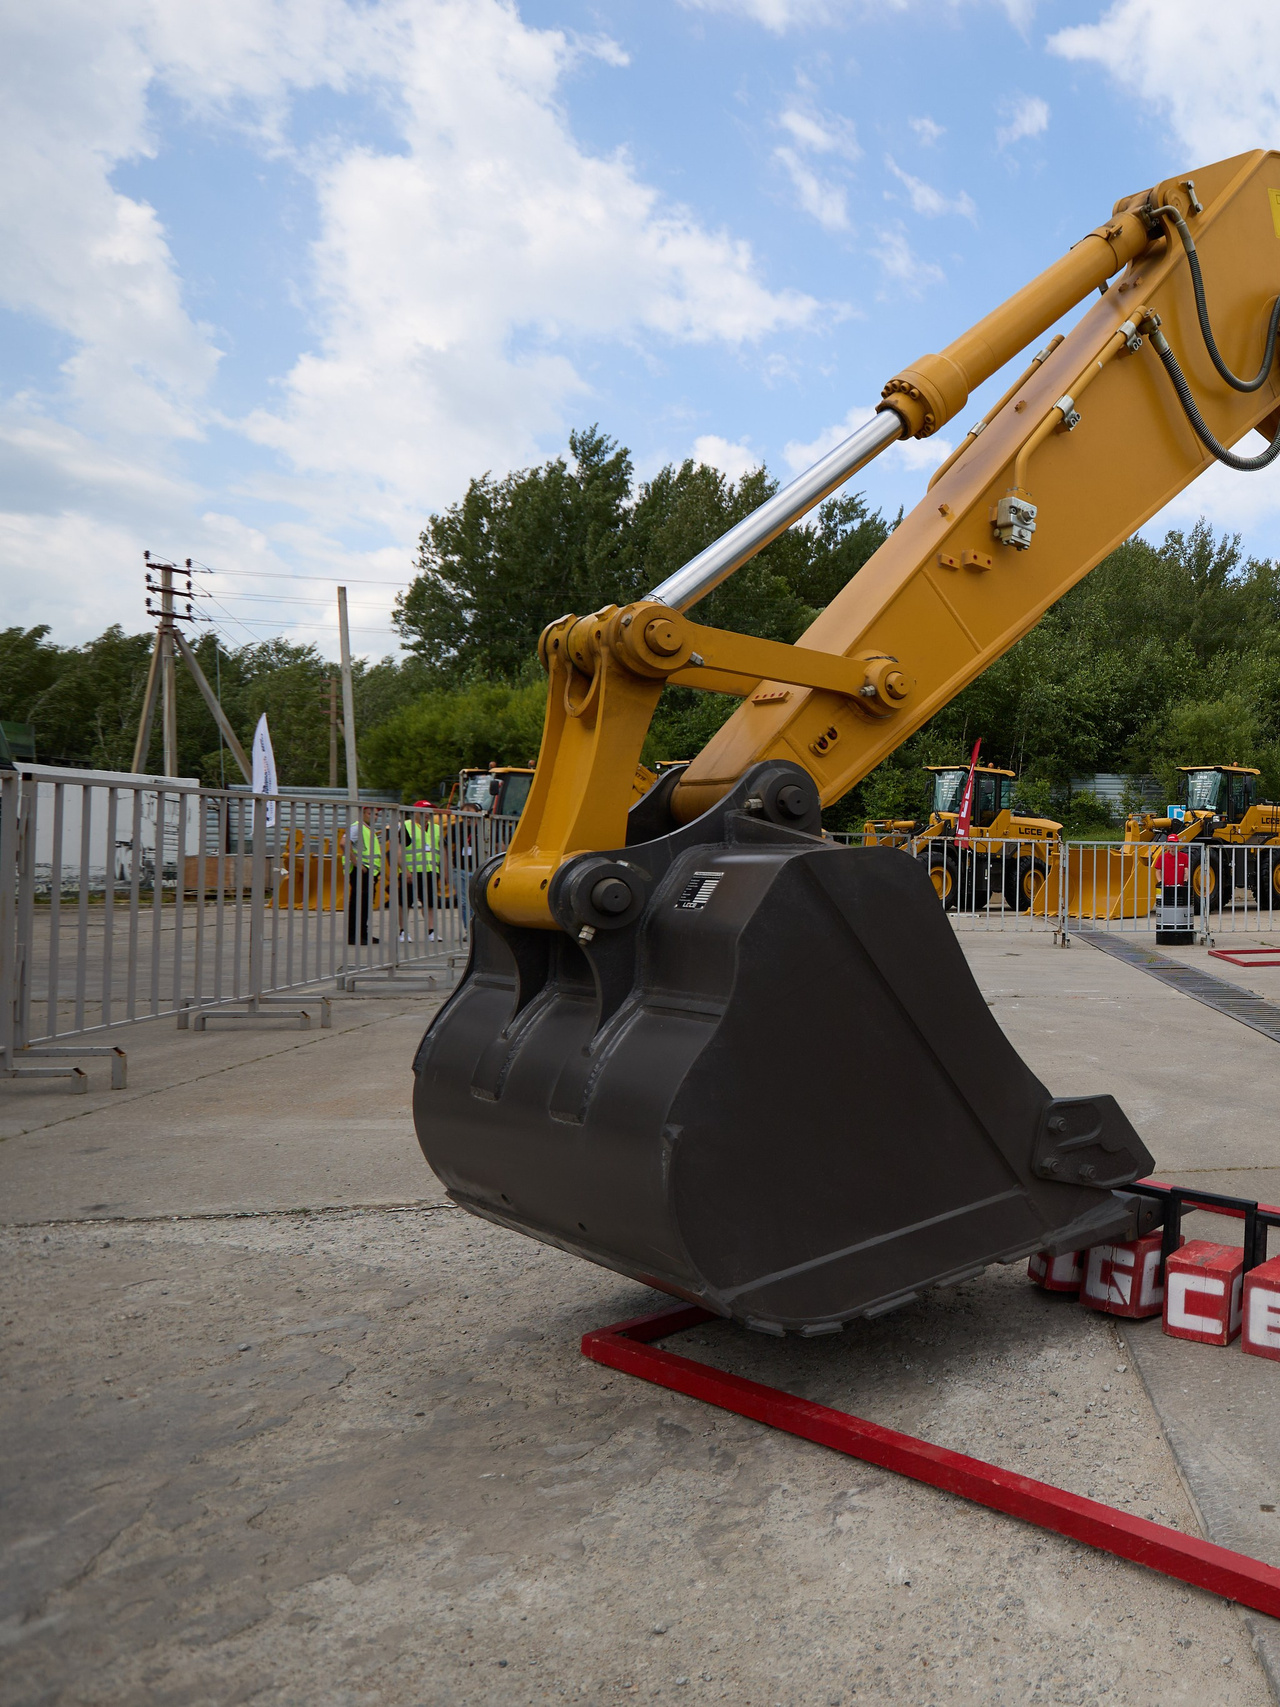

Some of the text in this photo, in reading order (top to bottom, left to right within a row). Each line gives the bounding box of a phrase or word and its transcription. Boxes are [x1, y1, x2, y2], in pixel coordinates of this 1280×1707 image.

[1261, 817, 1280, 825] LGCE
[1018, 826, 1043, 836] LGCE
[1167, 1271, 1226, 1335] C
